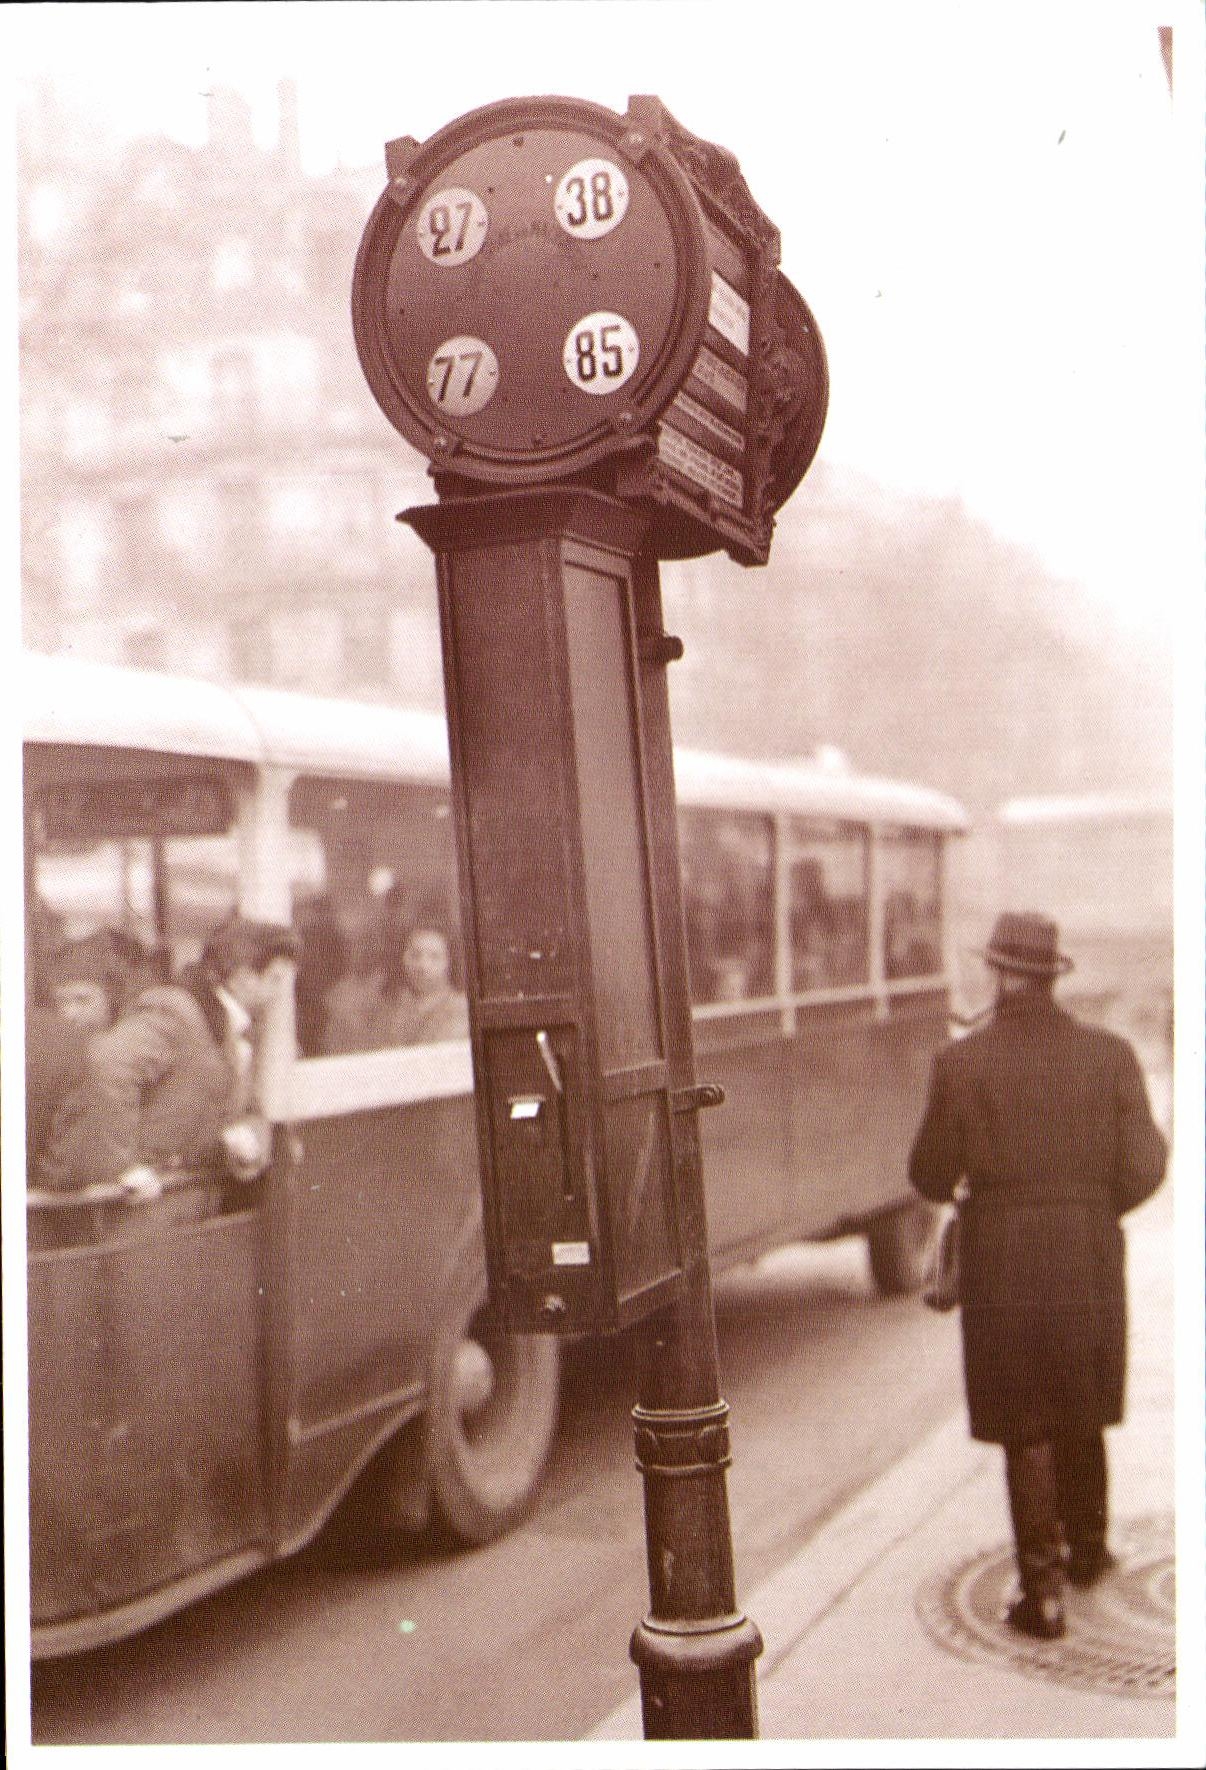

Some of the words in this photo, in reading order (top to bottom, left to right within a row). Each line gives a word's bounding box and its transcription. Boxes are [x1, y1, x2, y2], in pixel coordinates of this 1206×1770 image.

[565, 171, 612, 226] 38
[429, 202, 473, 257] 27
[435, 352, 483, 401] 77
[575, 325, 623, 381] 85
